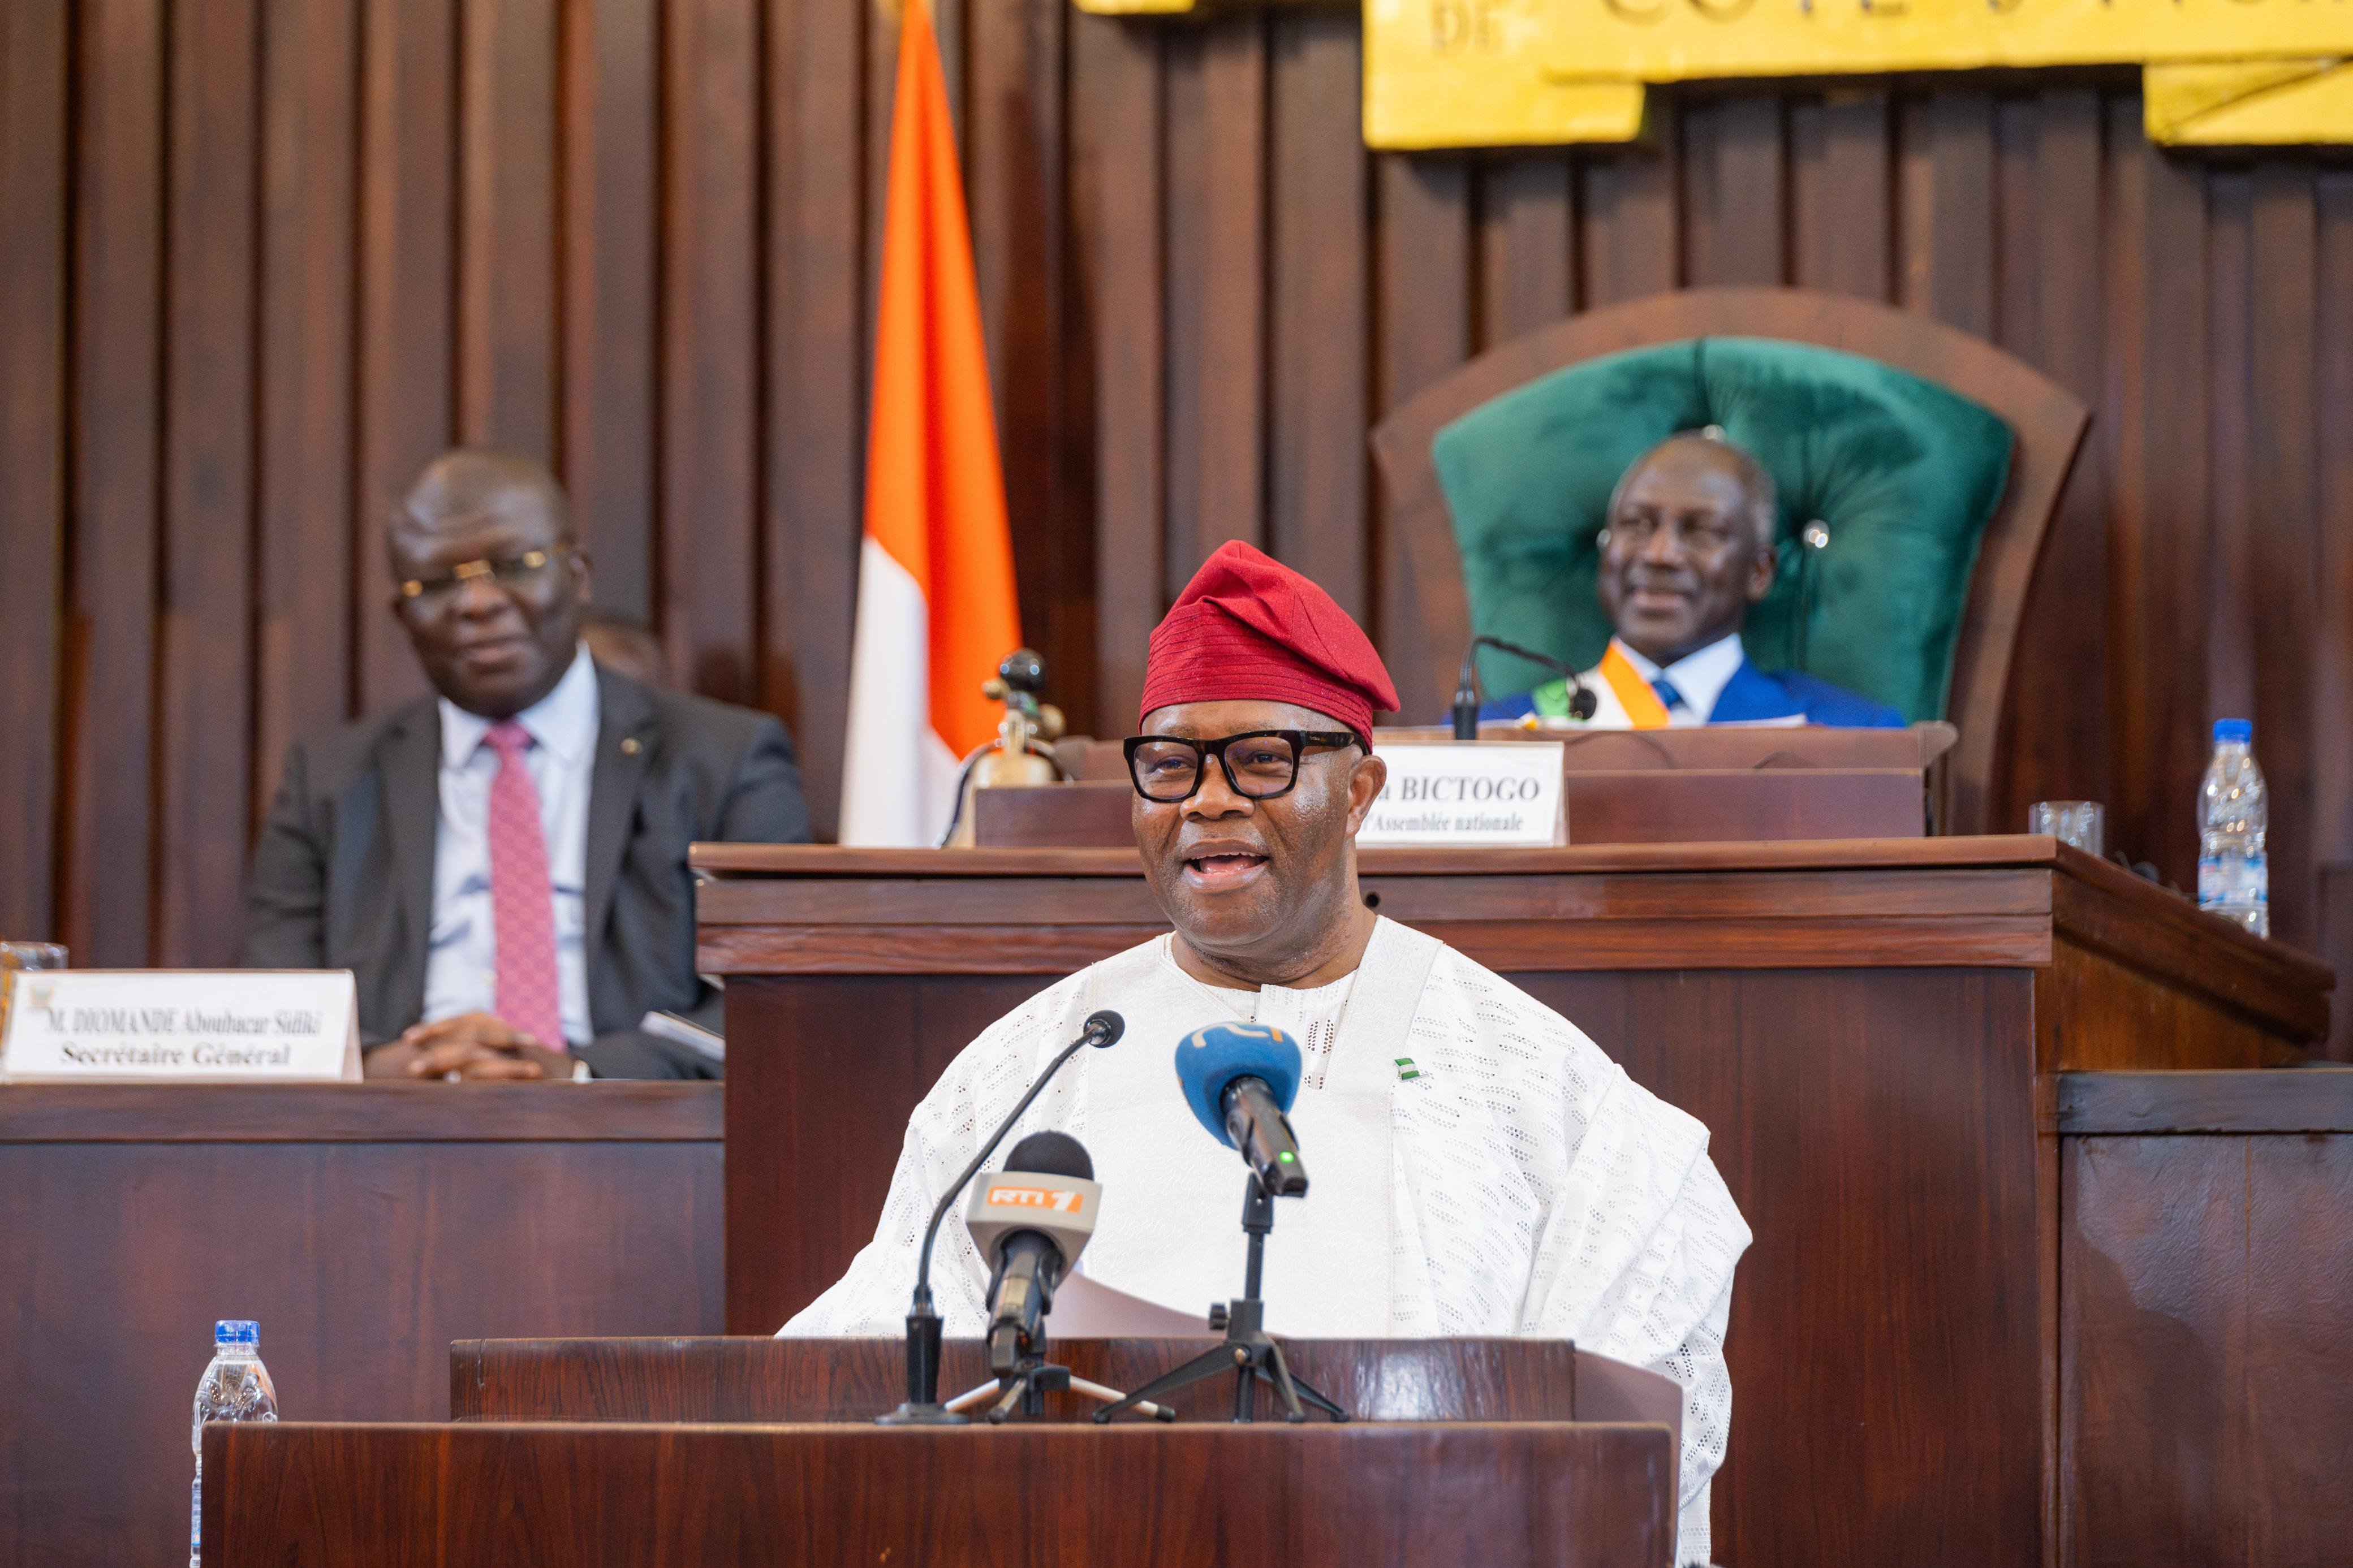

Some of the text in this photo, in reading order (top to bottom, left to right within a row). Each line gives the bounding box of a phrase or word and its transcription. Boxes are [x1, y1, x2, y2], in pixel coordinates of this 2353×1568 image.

[1402, 775, 1540, 801] BICTOGO
[1454, 811, 1524, 831] nationale
[61, 1040, 291, 1065] Secrétaire Général
